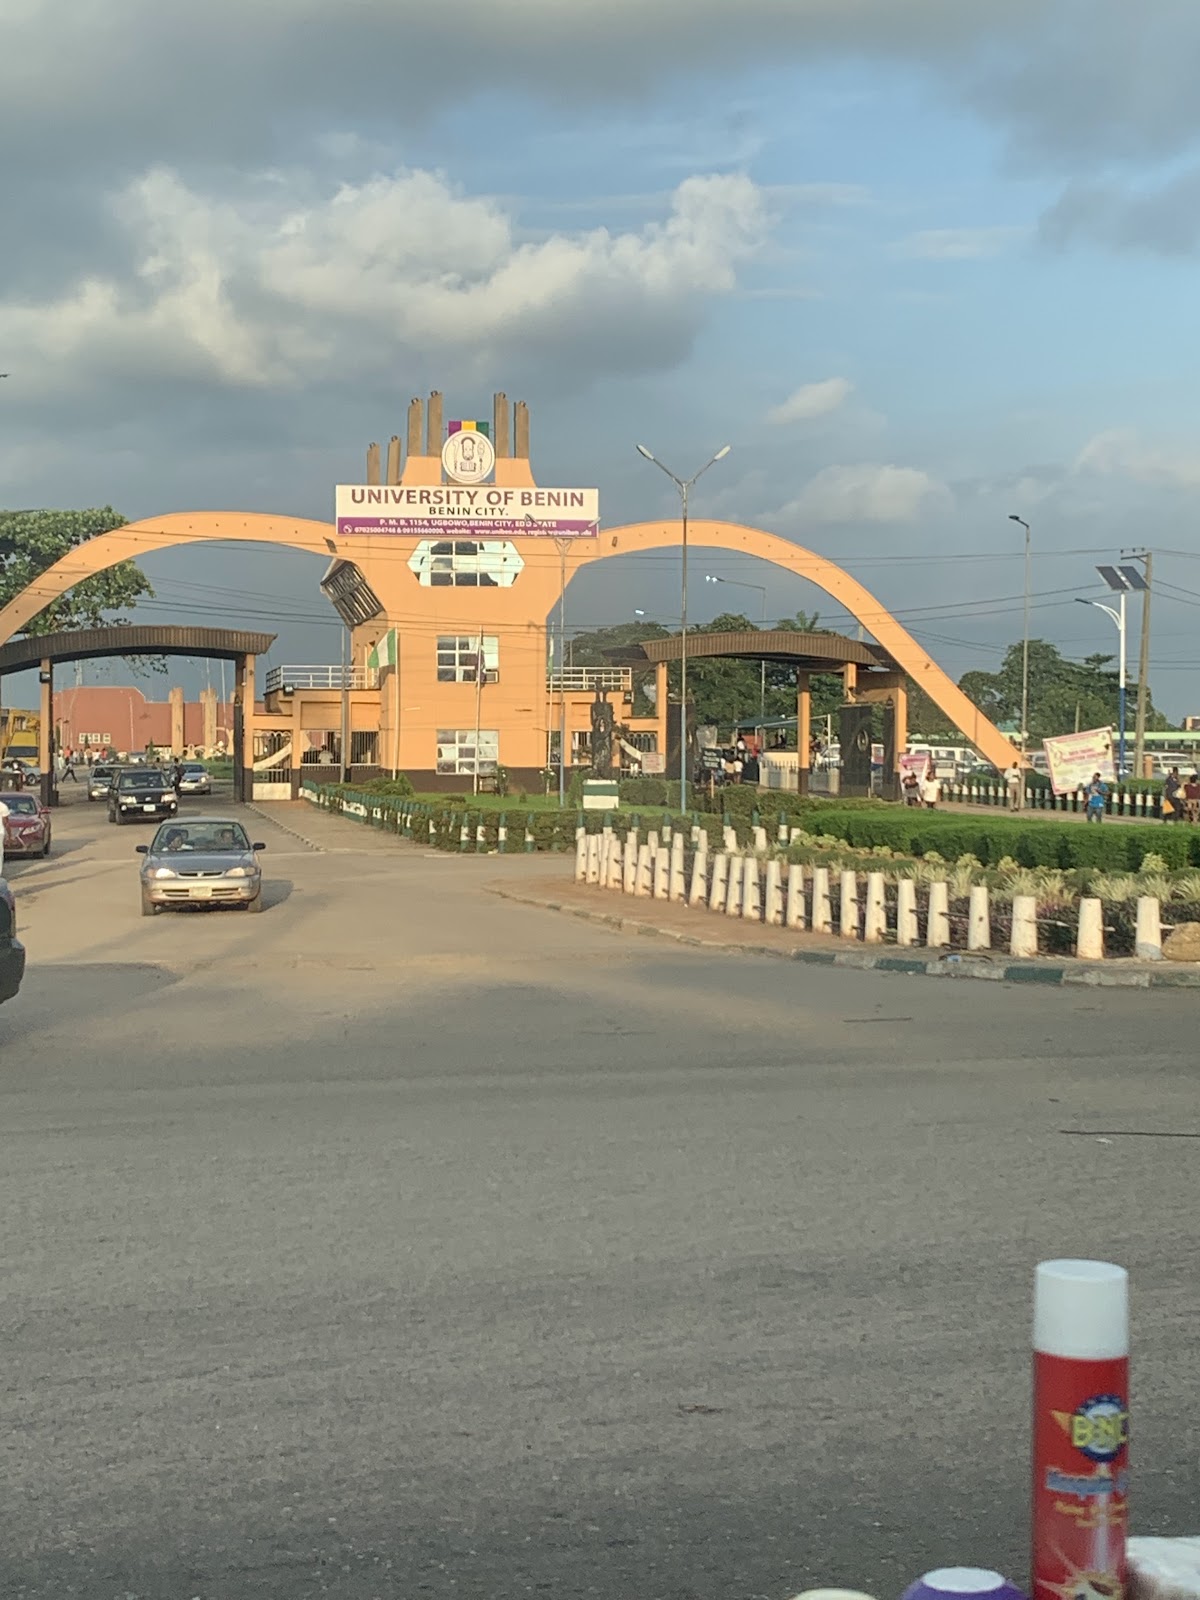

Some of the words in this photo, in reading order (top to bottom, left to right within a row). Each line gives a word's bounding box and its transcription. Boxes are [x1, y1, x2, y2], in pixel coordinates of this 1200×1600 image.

[351, 489, 478, 505] UNIVERSITY
[486, 491, 514, 506] OF
[521, 491, 584, 507] BENIN
[429, 507, 470, 516] BENIN
[475, 507, 509, 516] CITY.
